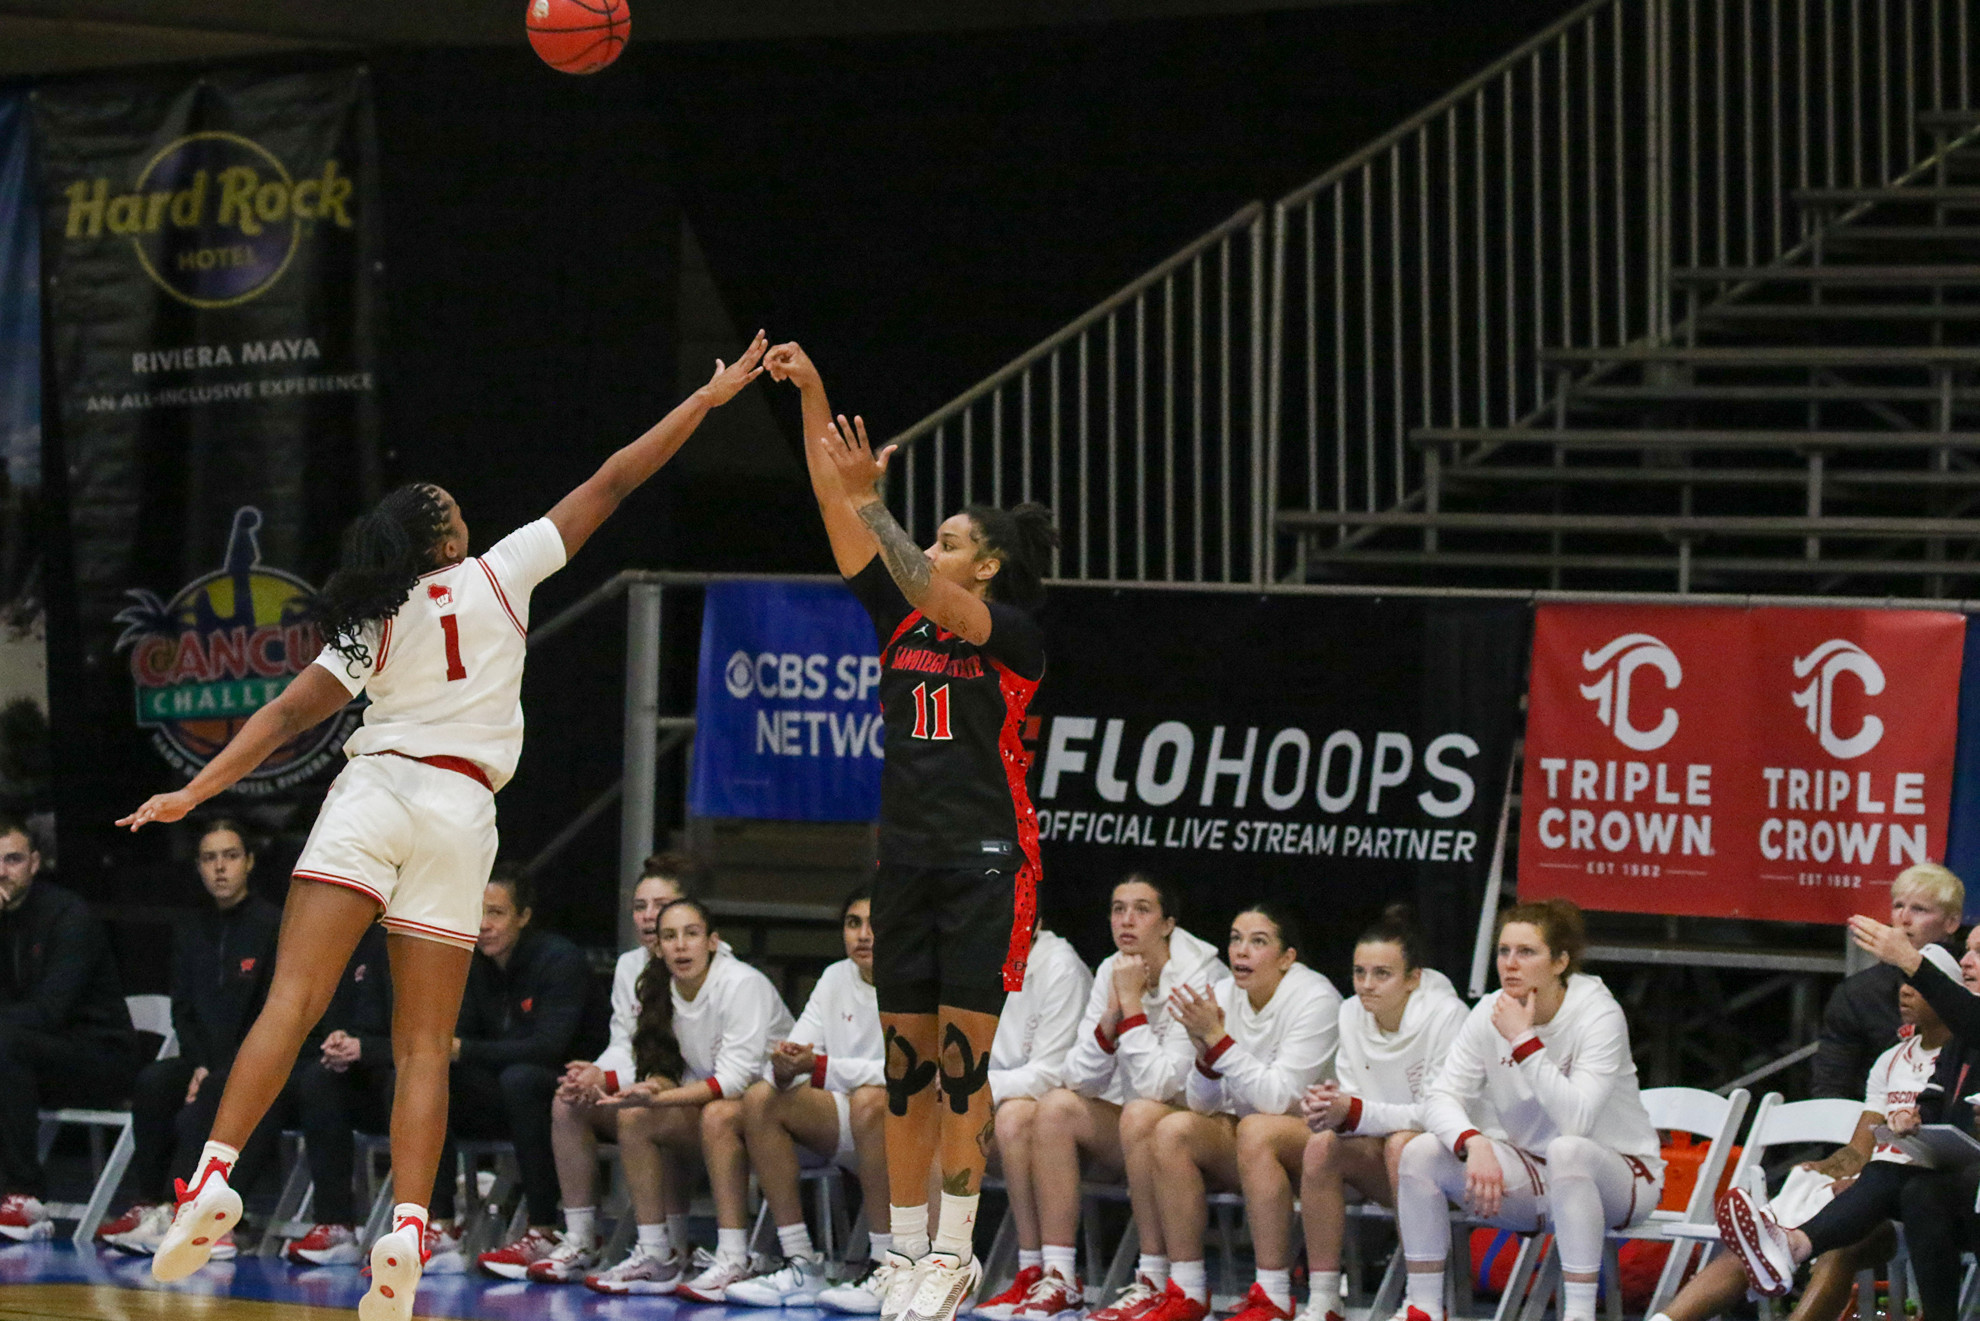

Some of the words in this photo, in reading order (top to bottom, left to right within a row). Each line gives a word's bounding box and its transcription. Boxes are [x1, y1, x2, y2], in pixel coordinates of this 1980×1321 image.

[64, 169, 207, 239] Hard
[217, 160, 353, 236] Rock
[178, 246, 258, 271] HOTEL
[132, 344, 233, 374] RIVIERA
[241, 337, 321, 364] MAYA
[86, 395, 116, 413] AN
[120, 381, 253, 409] ALL-INCLUSIVE
[259, 373, 374, 396] EXPERIENCE
[440, 613, 467, 681] 1
[756, 652, 829, 700] CBS
[911, 681, 953, 740] 11
[1540, 758, 1713, 806] TRIPLE
[1762, 767, 1926, 815] TRIPLE
[1037, 809, 1155, 848] OFFICIAL
[1164, 817, 1228, 851] LIVE
[1232, 821, 1337, 857] STREAM
[1341, 827, 1478, 864] PARTNER
[1538, 808, 1712, 857] CROWN
[1760, 819, 1926, 866] CROWN
